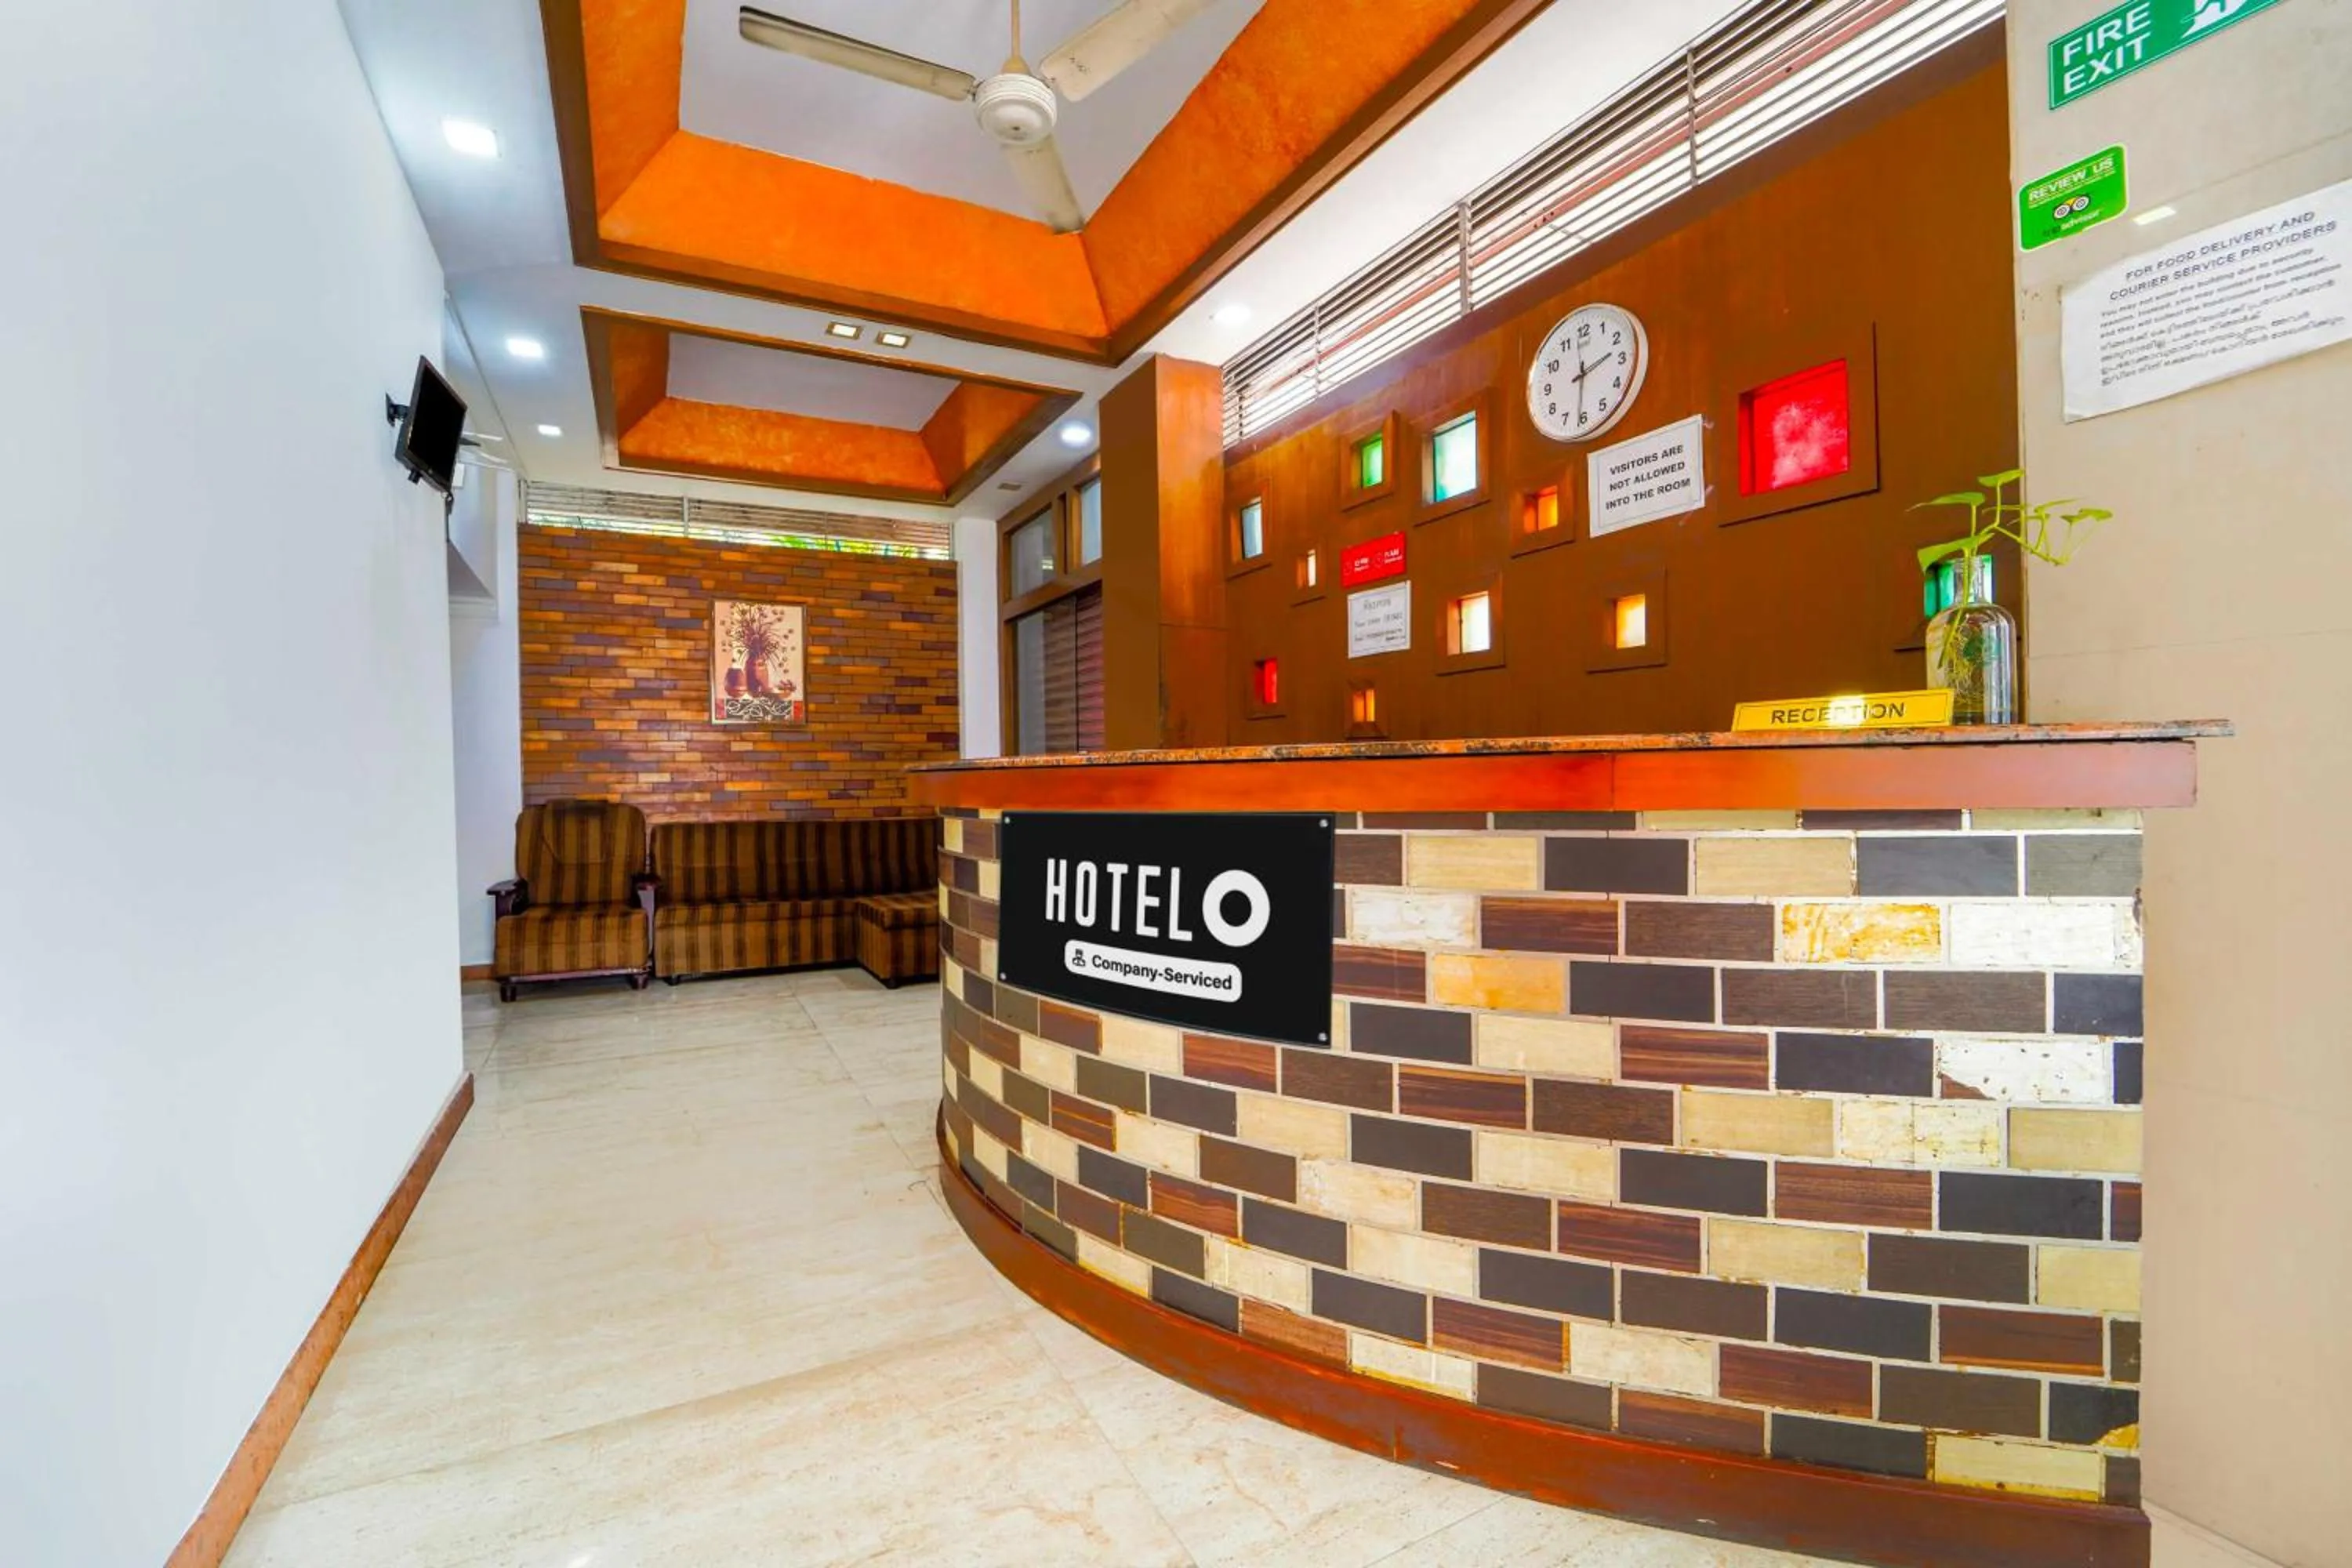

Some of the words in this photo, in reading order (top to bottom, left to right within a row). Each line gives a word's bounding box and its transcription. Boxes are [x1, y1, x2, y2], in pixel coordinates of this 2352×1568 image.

[2063, 1, 2151, 67] FIRE
[2063, 32, 2151, 95] EXIT
[2028, 169, 2086, 202] REVIEW
[2092, 157, 2114, 174] US
[2125, 265, 2153, 280] FOR
[2157, 250, 2196, 270] FOOD
[2200, 223, 2275, 256] DELIVERY
[2280, 211, 2315, 230] AND
[2110, 274, 2169, 301] COURIER
[2173, 252, 2236, 280] SERVICE
[2241, 220, 2337, 257] PROVIDERS
[1577, 324, 1590, 338] 12
[1599, 321, 1606, 334] 1
[1561, 338, 1571, 352] 11
[1613, 332, 1621, 346] 2
[1617, 352, 1627, 365] 3
[1548, 360, 1559, 374] 10
[1544, 383, 1552, 396] 9
[1613, 376, 1621, 389] 4
[1548, 403, 1555, 415] 8
[1599, 398, 1606, 412] 5
[1562, 412, 1569, 426] 7
[1580, 411, 1588, 424] 6
[1610, 452, 1658, 476] VISITORS
[1662, 445, 1683, 458] ARE
[1610, 477, 1630, 492] NOT
[1634, 461, 1685, 484] ALLOWED
[1606, 495, 1630, 510] INTO
[1634, 489, 1653, 501] THE
[1657, 477, 1690, 495] ROOM
[1045, 858, 1192, 941] HOTEL
[1091, 954, 1232, 989] Company-Serviced
